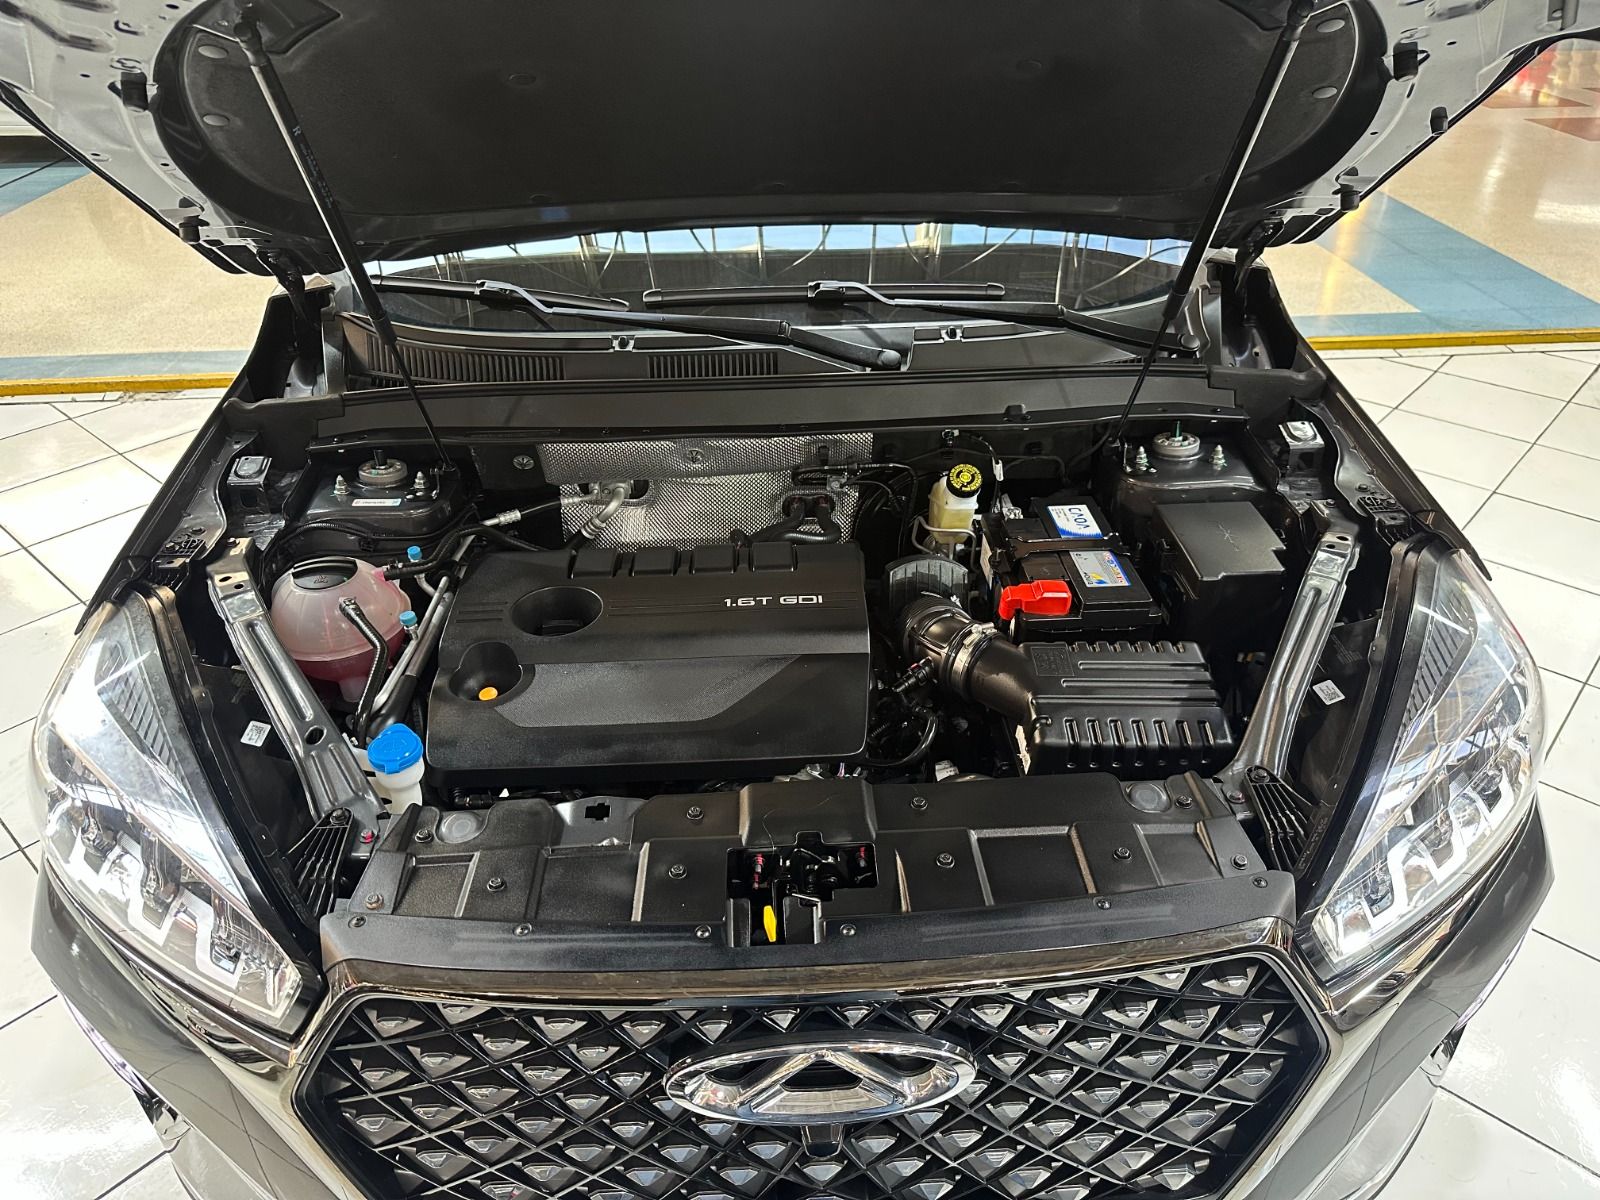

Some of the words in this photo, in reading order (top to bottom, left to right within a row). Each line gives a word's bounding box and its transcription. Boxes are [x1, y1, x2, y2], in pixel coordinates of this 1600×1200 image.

[292, 126, 302, 137] R
[724, 596, 773, 607] 1.6T
[779, 595, 823, 605] GDI
